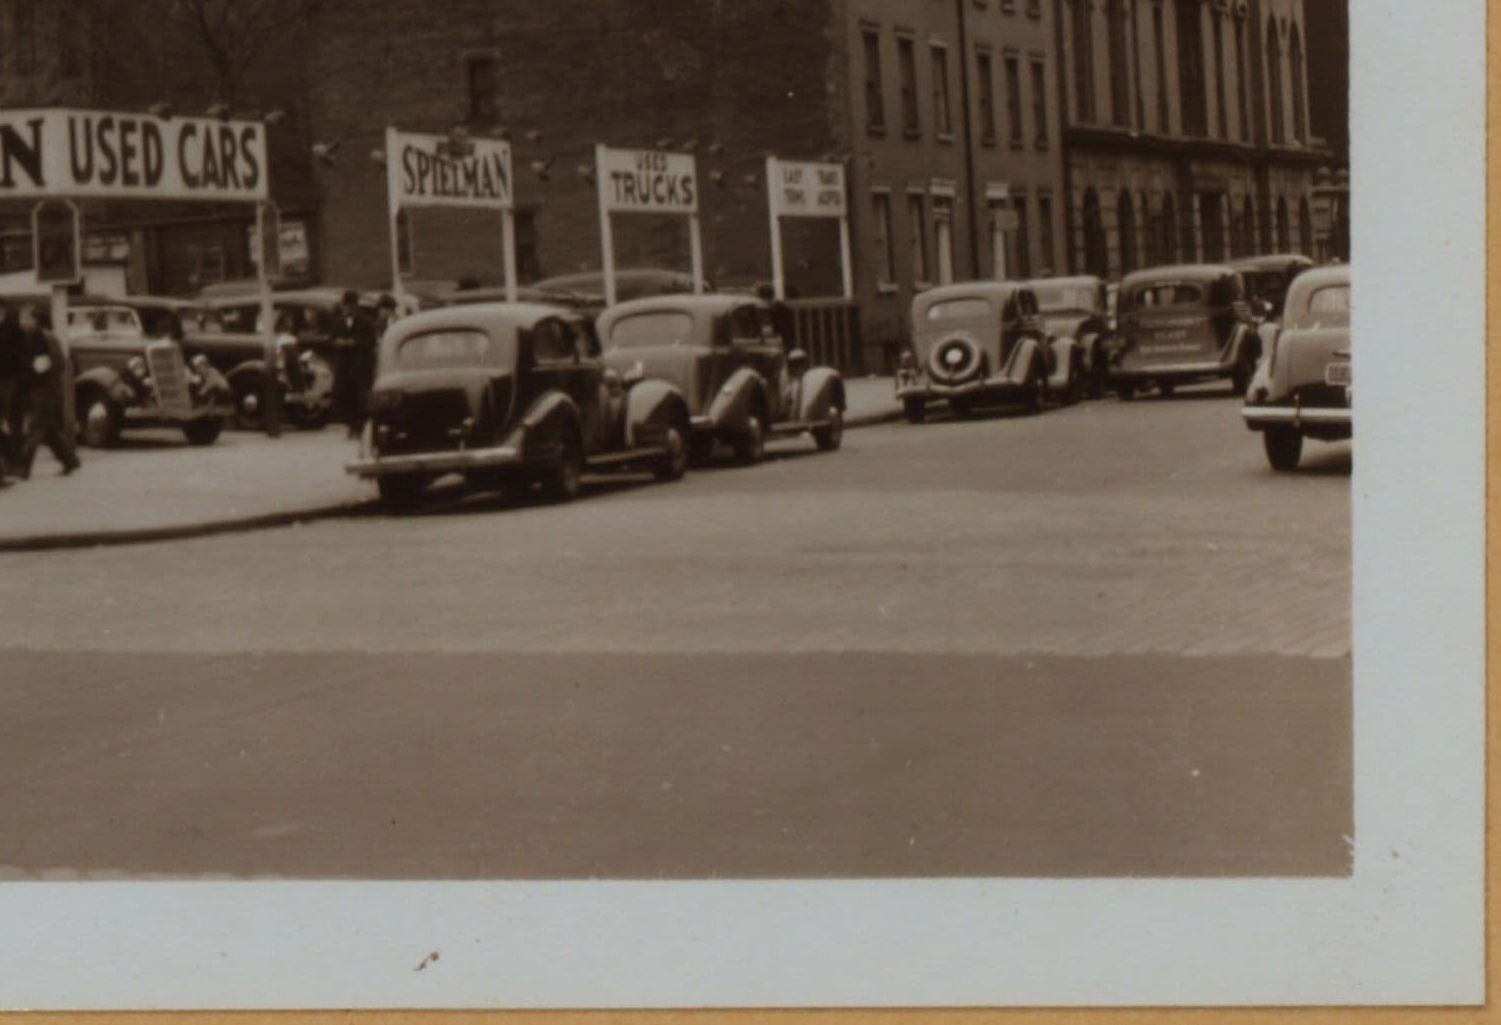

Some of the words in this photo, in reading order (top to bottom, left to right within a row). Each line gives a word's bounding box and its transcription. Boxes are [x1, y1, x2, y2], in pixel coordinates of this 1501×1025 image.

[68, 116, 165, 187] USED
[178, 123, 259, 191] CARS
[402, 142, 509, 199] SPIELMAN
[636, 153, 667, 172] USED
[611, 171, 694, 206] TRUCKS
